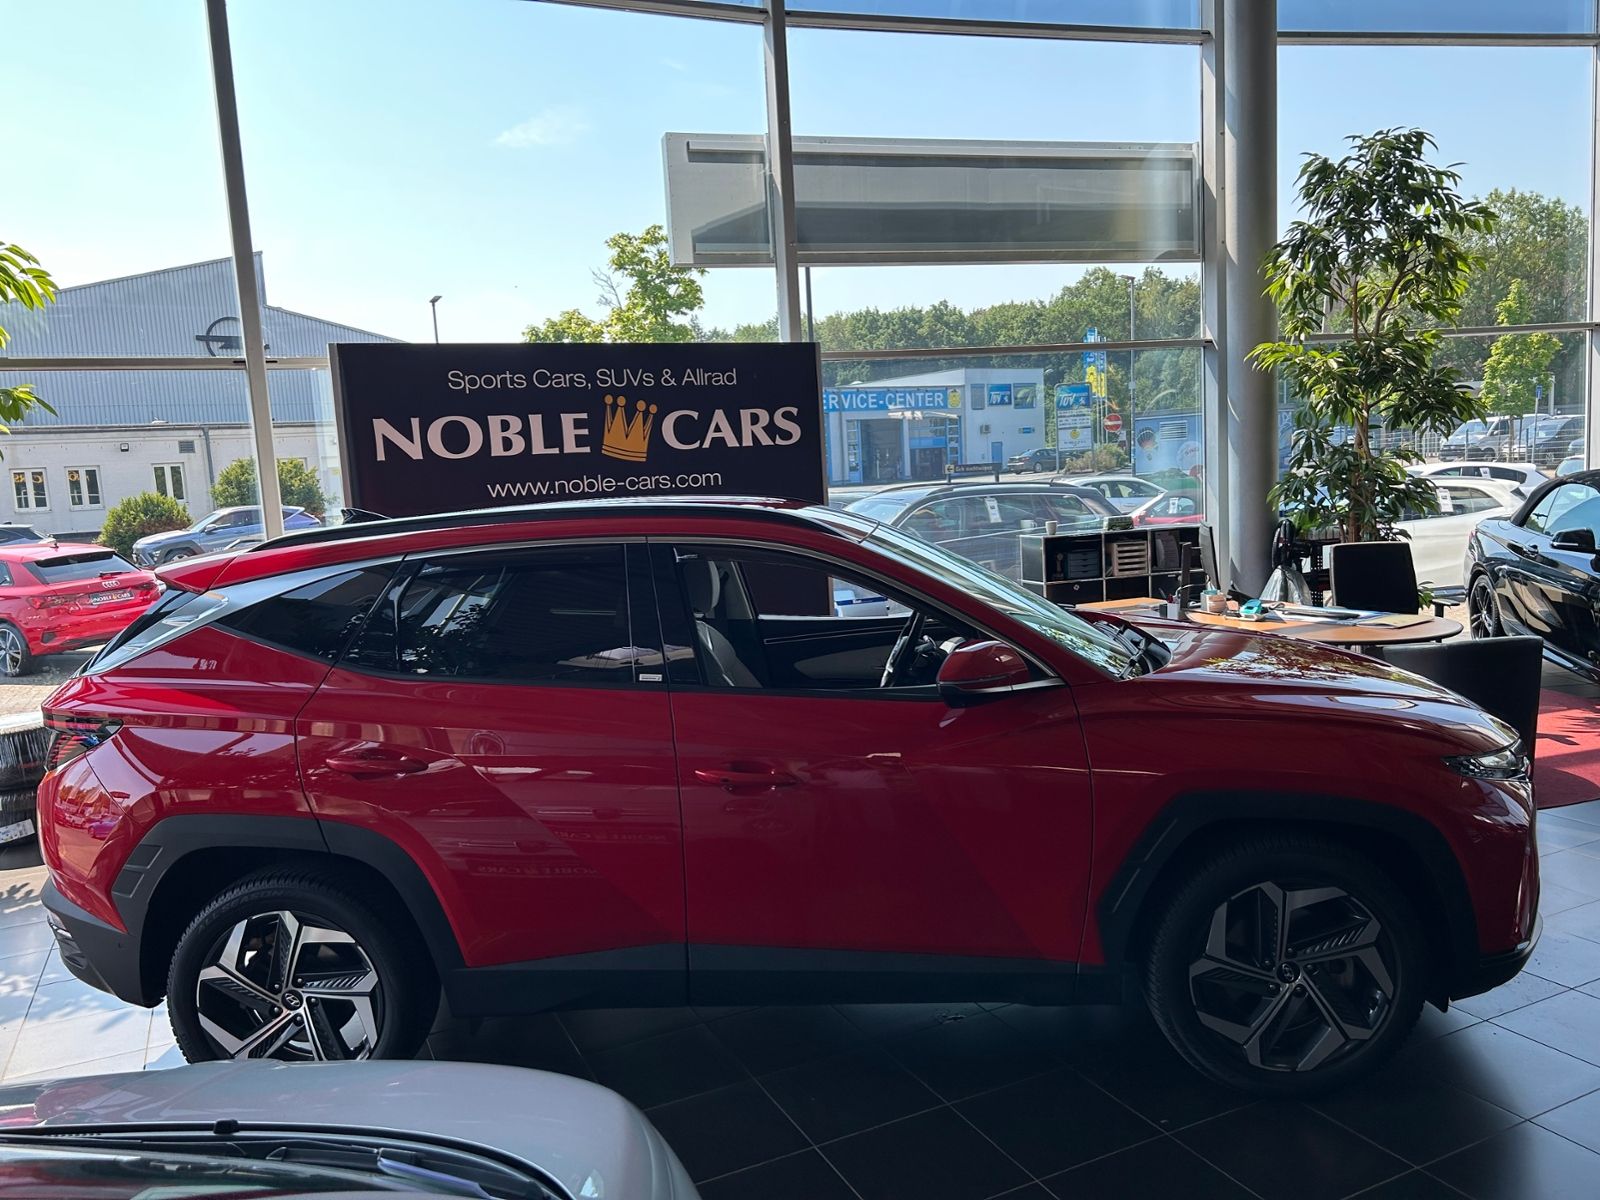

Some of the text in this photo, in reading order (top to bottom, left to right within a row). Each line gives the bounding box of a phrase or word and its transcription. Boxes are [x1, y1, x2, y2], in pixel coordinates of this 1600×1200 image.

[447, 368, 737, 393] Sports Cars, SUVs & Allrad
[372, 406, 802, 462] NOBLE CARS
[487, 469, 723, 498] www.noble-cars.com
